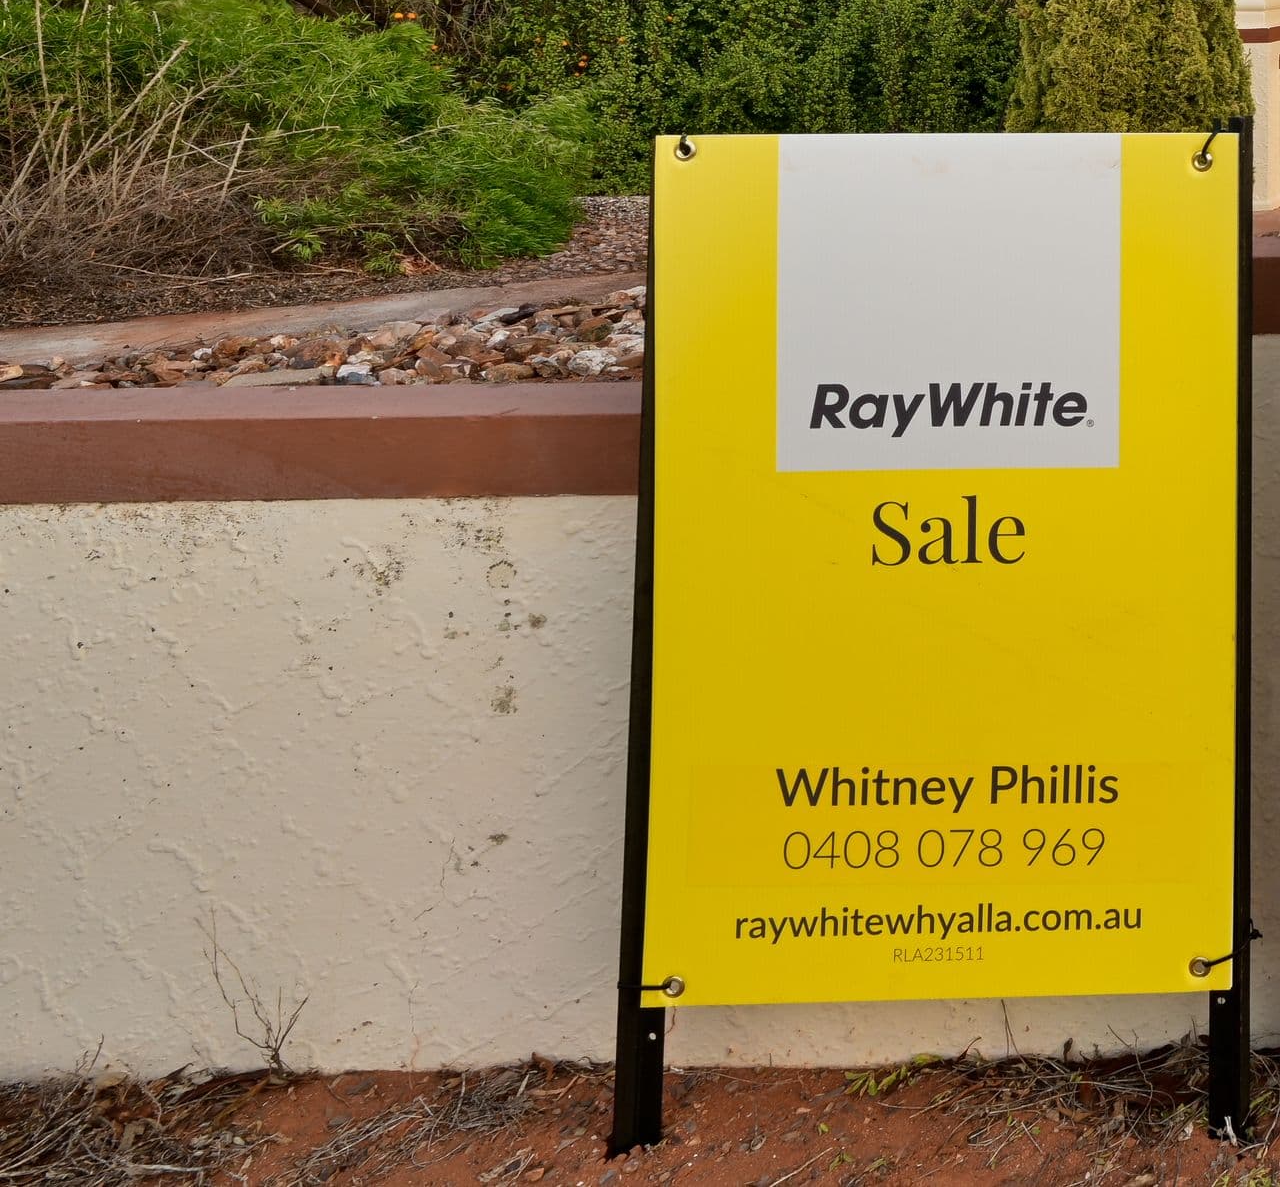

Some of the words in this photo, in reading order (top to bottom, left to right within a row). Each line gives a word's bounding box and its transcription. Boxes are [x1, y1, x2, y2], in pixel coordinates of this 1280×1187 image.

[871, 494, 1026, 567] Sale
[775, 765, 975, 814] Whitney
[990, 763, 1120, 806] Phillis
[782, 829, 900, 870] 0408
[916, 827, 1003, 869] 078
[1021, 826, 1106, 868] 969
[734, 901, 1143, 945] raywhitewhyalla.com.au
[892, 945, 985, 963] RLA231511
